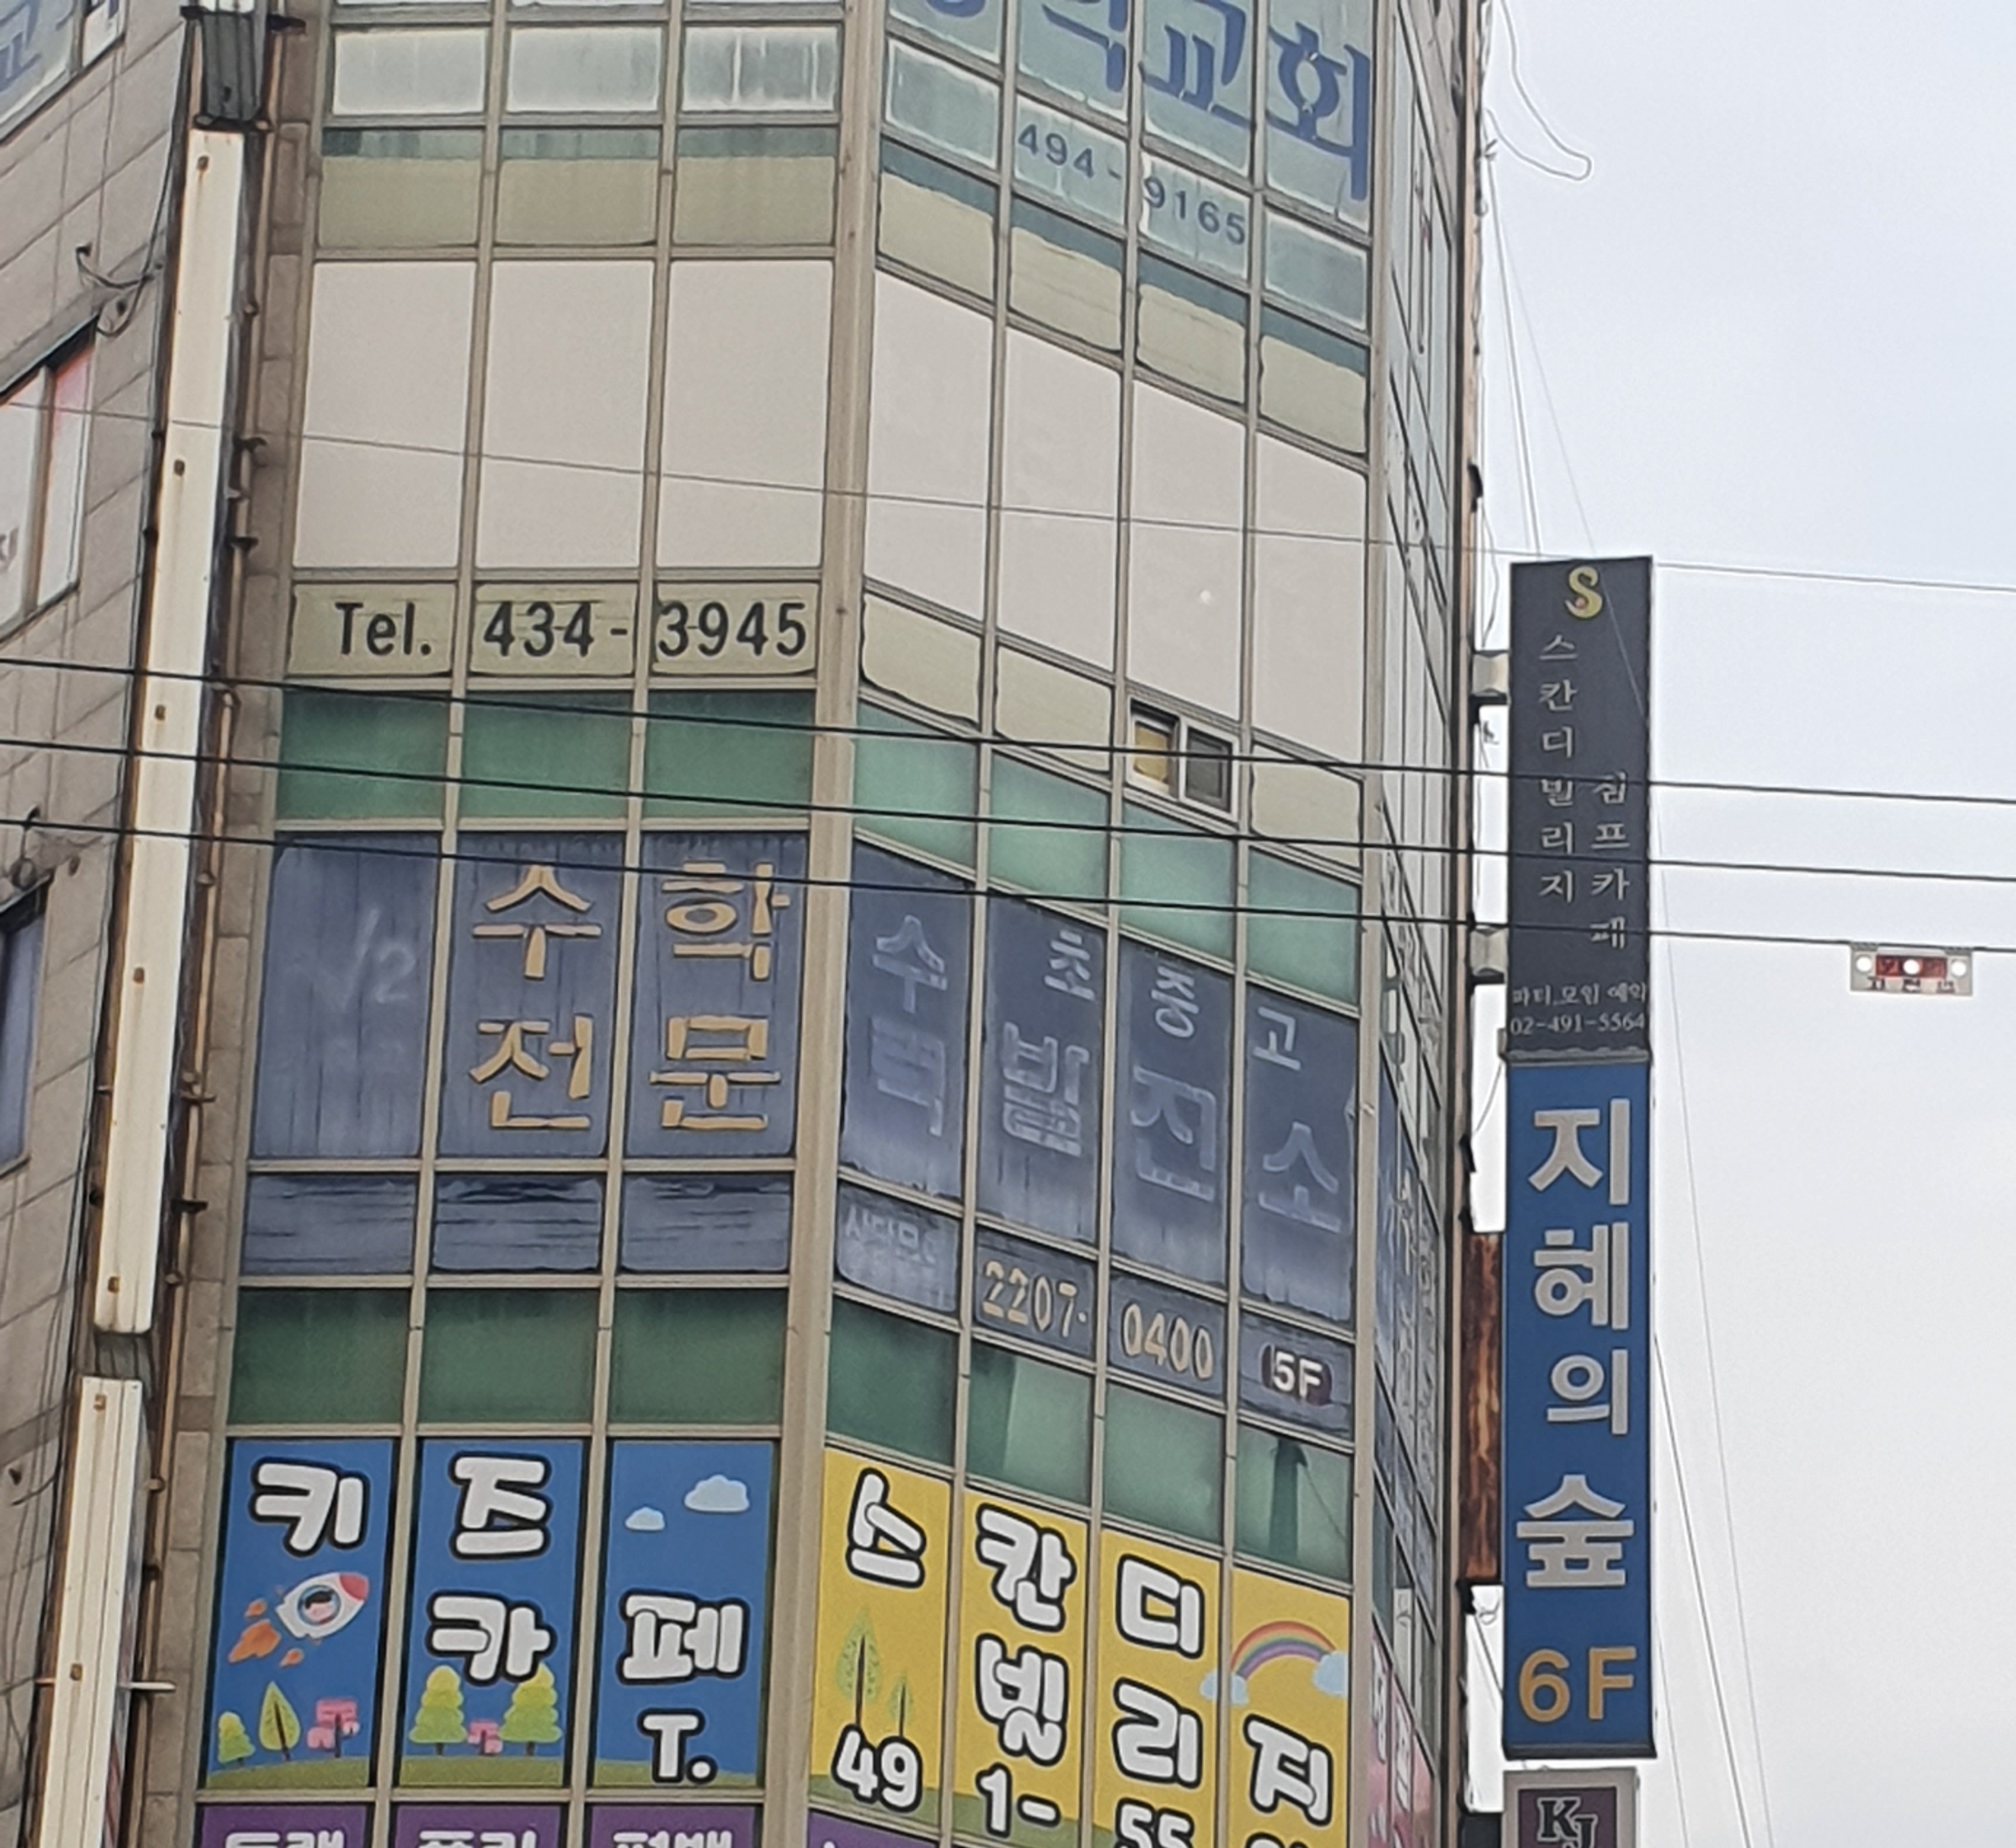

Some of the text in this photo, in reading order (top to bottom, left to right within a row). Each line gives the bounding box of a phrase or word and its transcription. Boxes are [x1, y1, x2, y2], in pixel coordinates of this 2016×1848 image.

[1017, 123, 1245, 245] 494-9165
[335, 599, 807, 657] Tel. 434-3945
[1565, 566, 1603, 619] S
[472, 859, 791, 981] 수학
[469, 1014, 781, 1131] 전문
[1273, 1350, 1323, 1399] 5F
[1516, 1097, 1637, 1723] 지혜의 숲 6F
[251, 1453, 549, 1558] 키즈
[429, 1591, 747, 1683] 카페
[640, 1709, 716, 1783] T.
